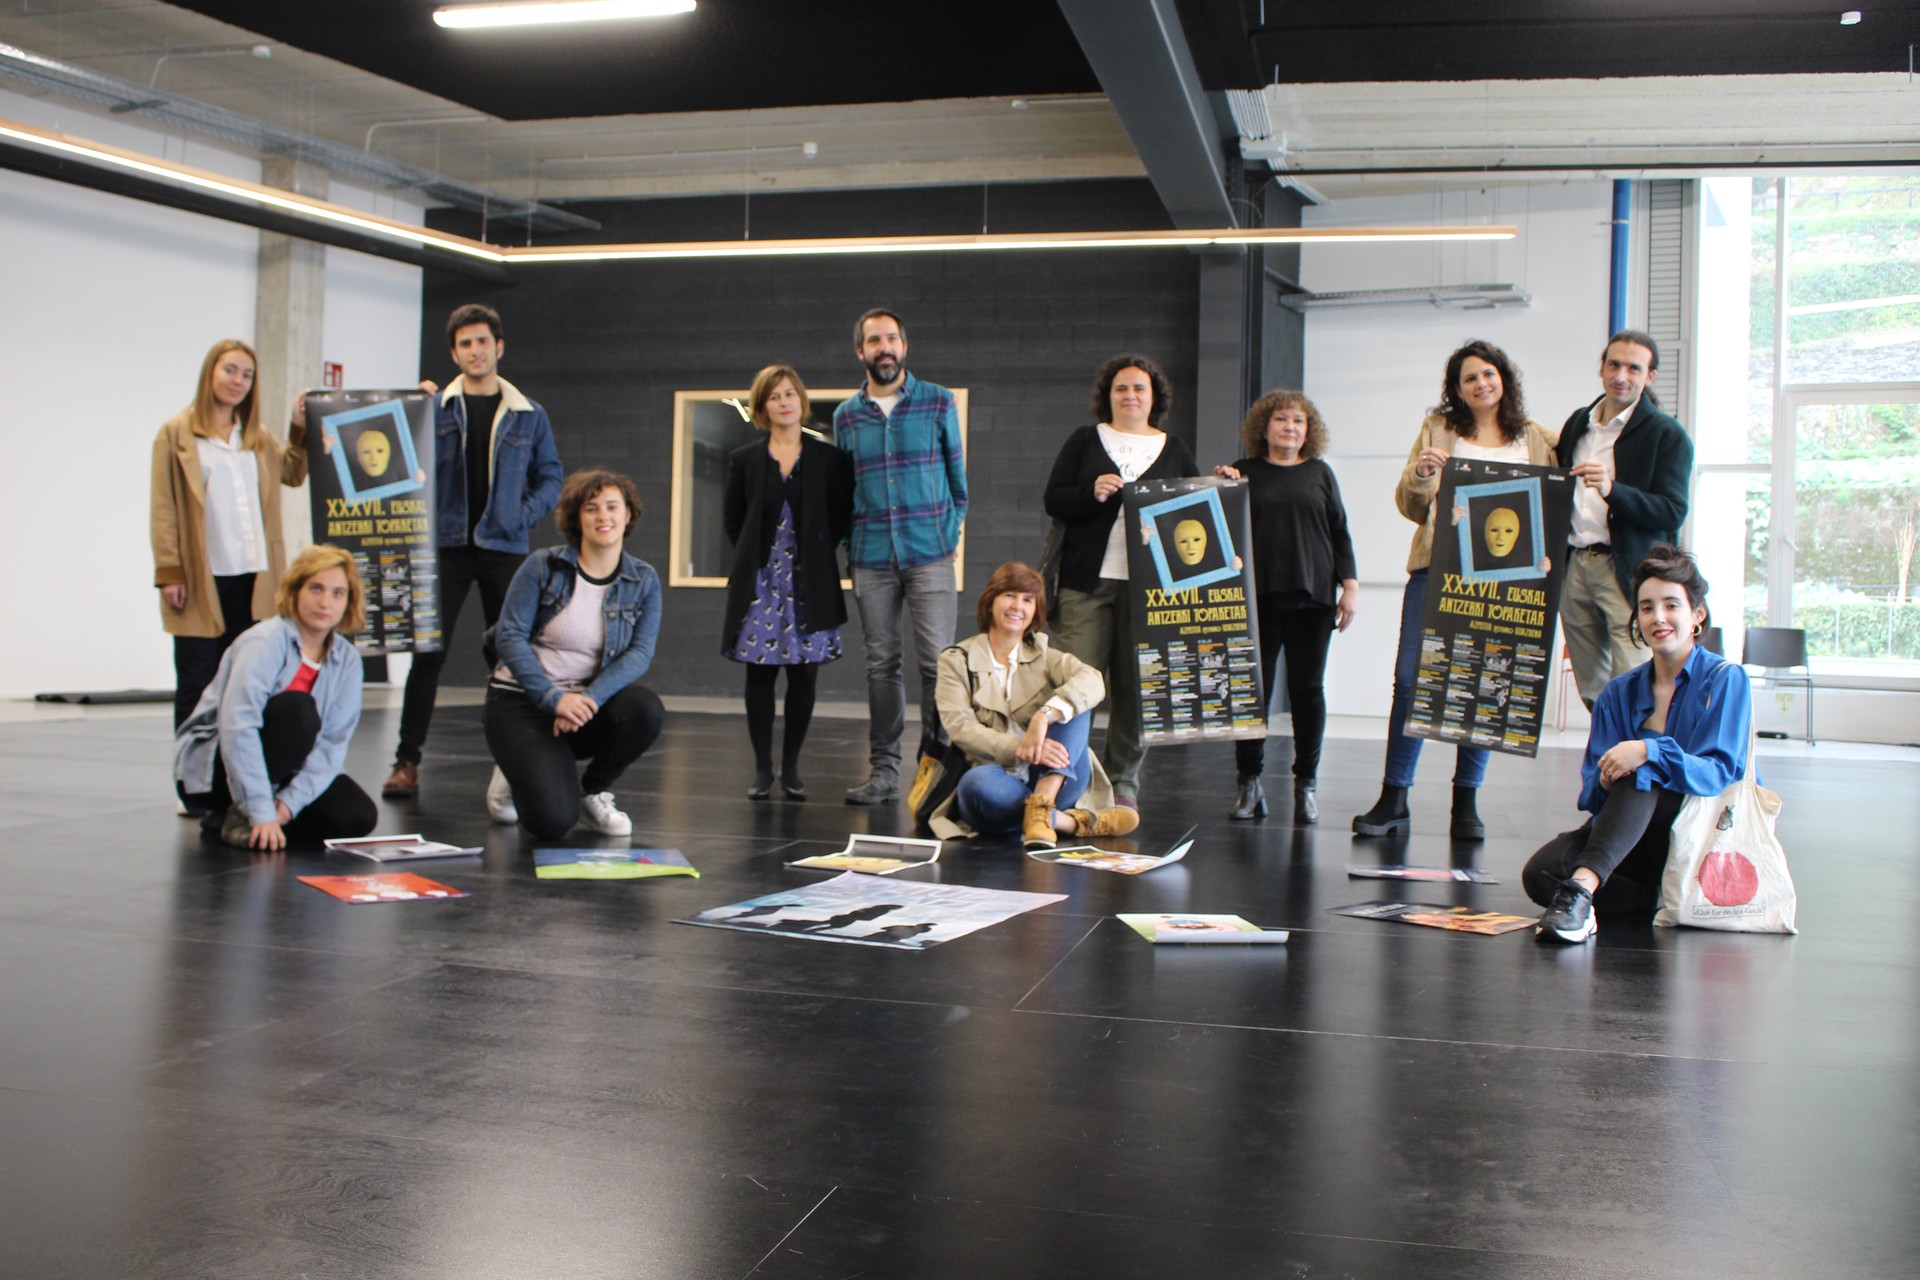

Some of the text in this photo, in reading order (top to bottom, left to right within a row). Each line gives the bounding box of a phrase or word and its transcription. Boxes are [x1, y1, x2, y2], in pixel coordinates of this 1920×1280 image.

[1145, 586, 1246, 607] XXXVII. EUSKAL
[1441, 572, 1547, 607] XXXVII. EUSKAL
[1147, 605, 1247, 626] ANTZERKI TOPAKETAK
[1438, 597, 1546, 627] ANTZERKI TOPAKETAK
